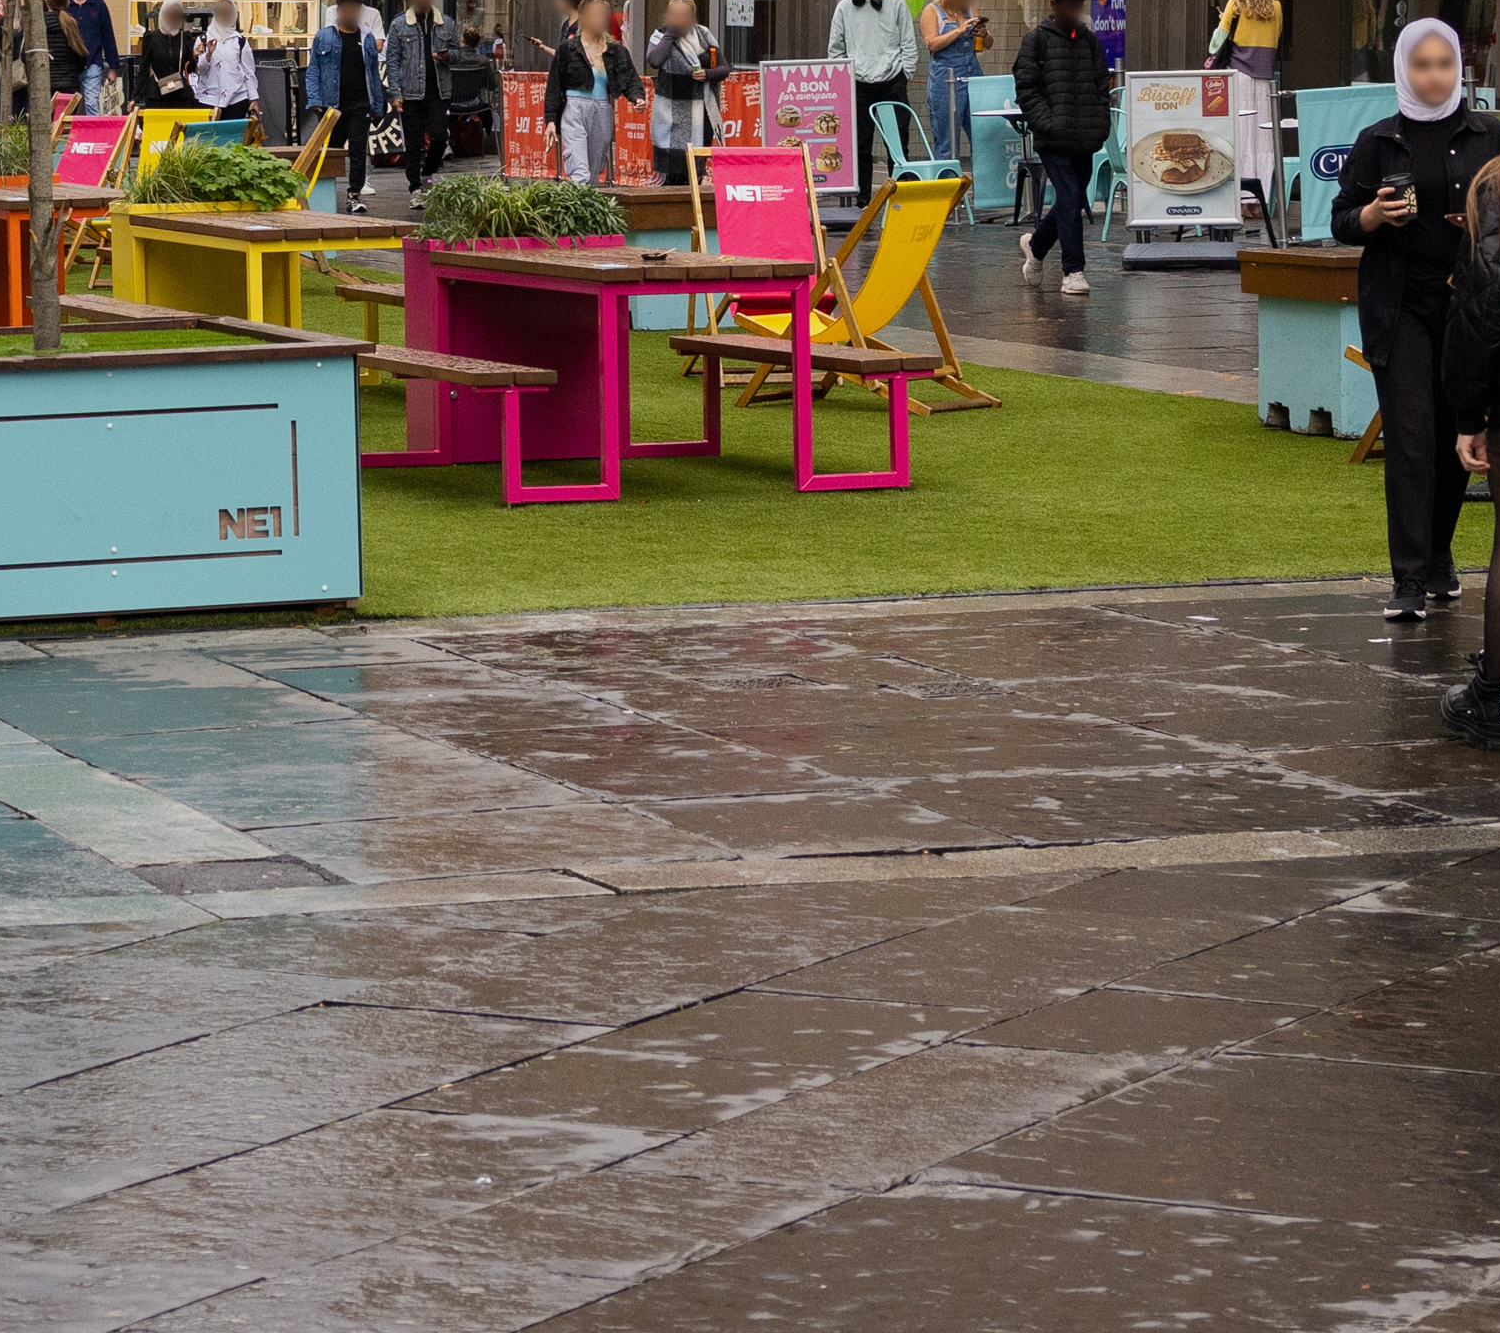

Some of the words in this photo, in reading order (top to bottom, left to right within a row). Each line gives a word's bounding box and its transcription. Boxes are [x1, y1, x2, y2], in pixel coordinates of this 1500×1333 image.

[1094, 16, 1115, 31] don't
[786, 82, 798, 93] A
[799, 81, 830, 93] BON
[777, 92, 795, 105] for
[795, 91, 839, 103] everyone
[1136, 87, 1197, 106] Biscoff
[1154, 101, 1178, 111] BON
[721, 119, 743, 139] O!
[70, 141, 96, 155] NE1
[725, 184, 762, 203] NE1
[218, 506, 282, 540] NE1
